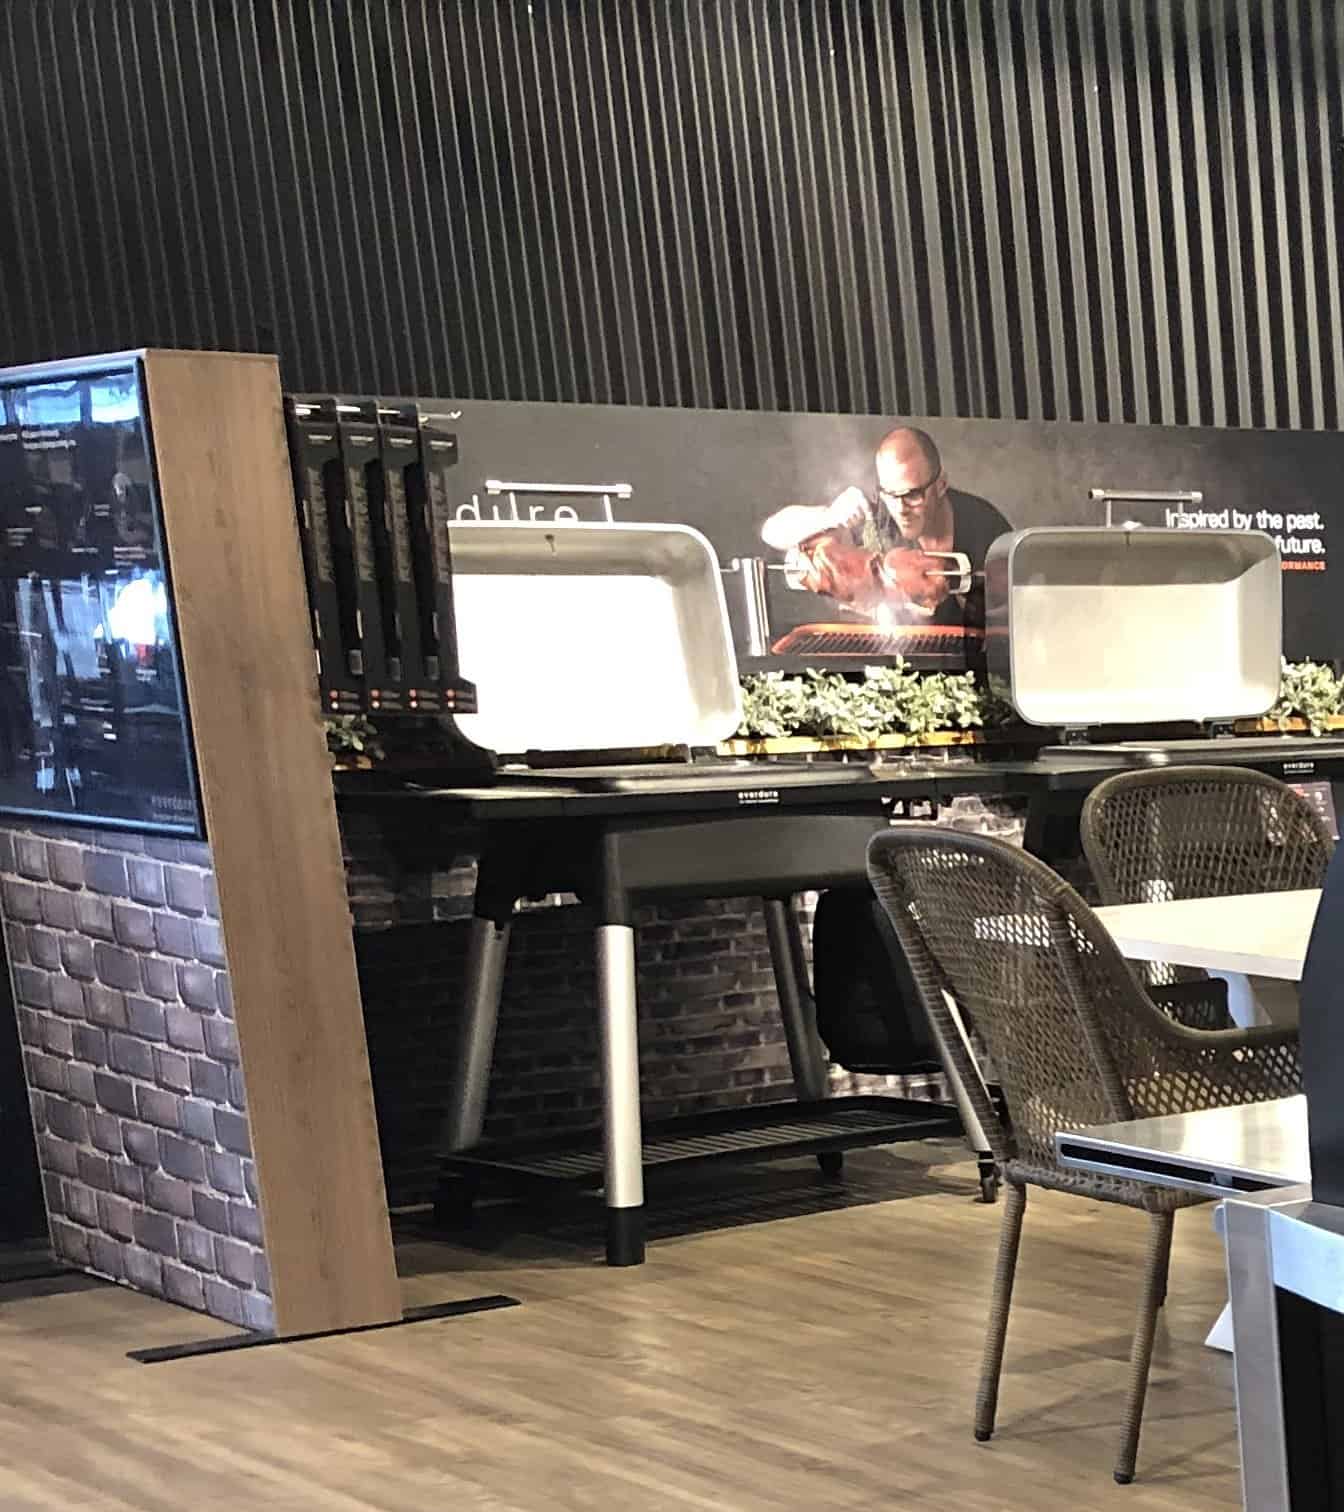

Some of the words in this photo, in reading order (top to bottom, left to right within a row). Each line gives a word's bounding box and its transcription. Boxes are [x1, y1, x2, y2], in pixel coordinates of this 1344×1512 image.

[1165, 508, 1229, 529] Inspired
[1232, 509, 1253, 531] by
[1256, 510, 1283, 529] the
[1286, 512, 1325, 533] past.
